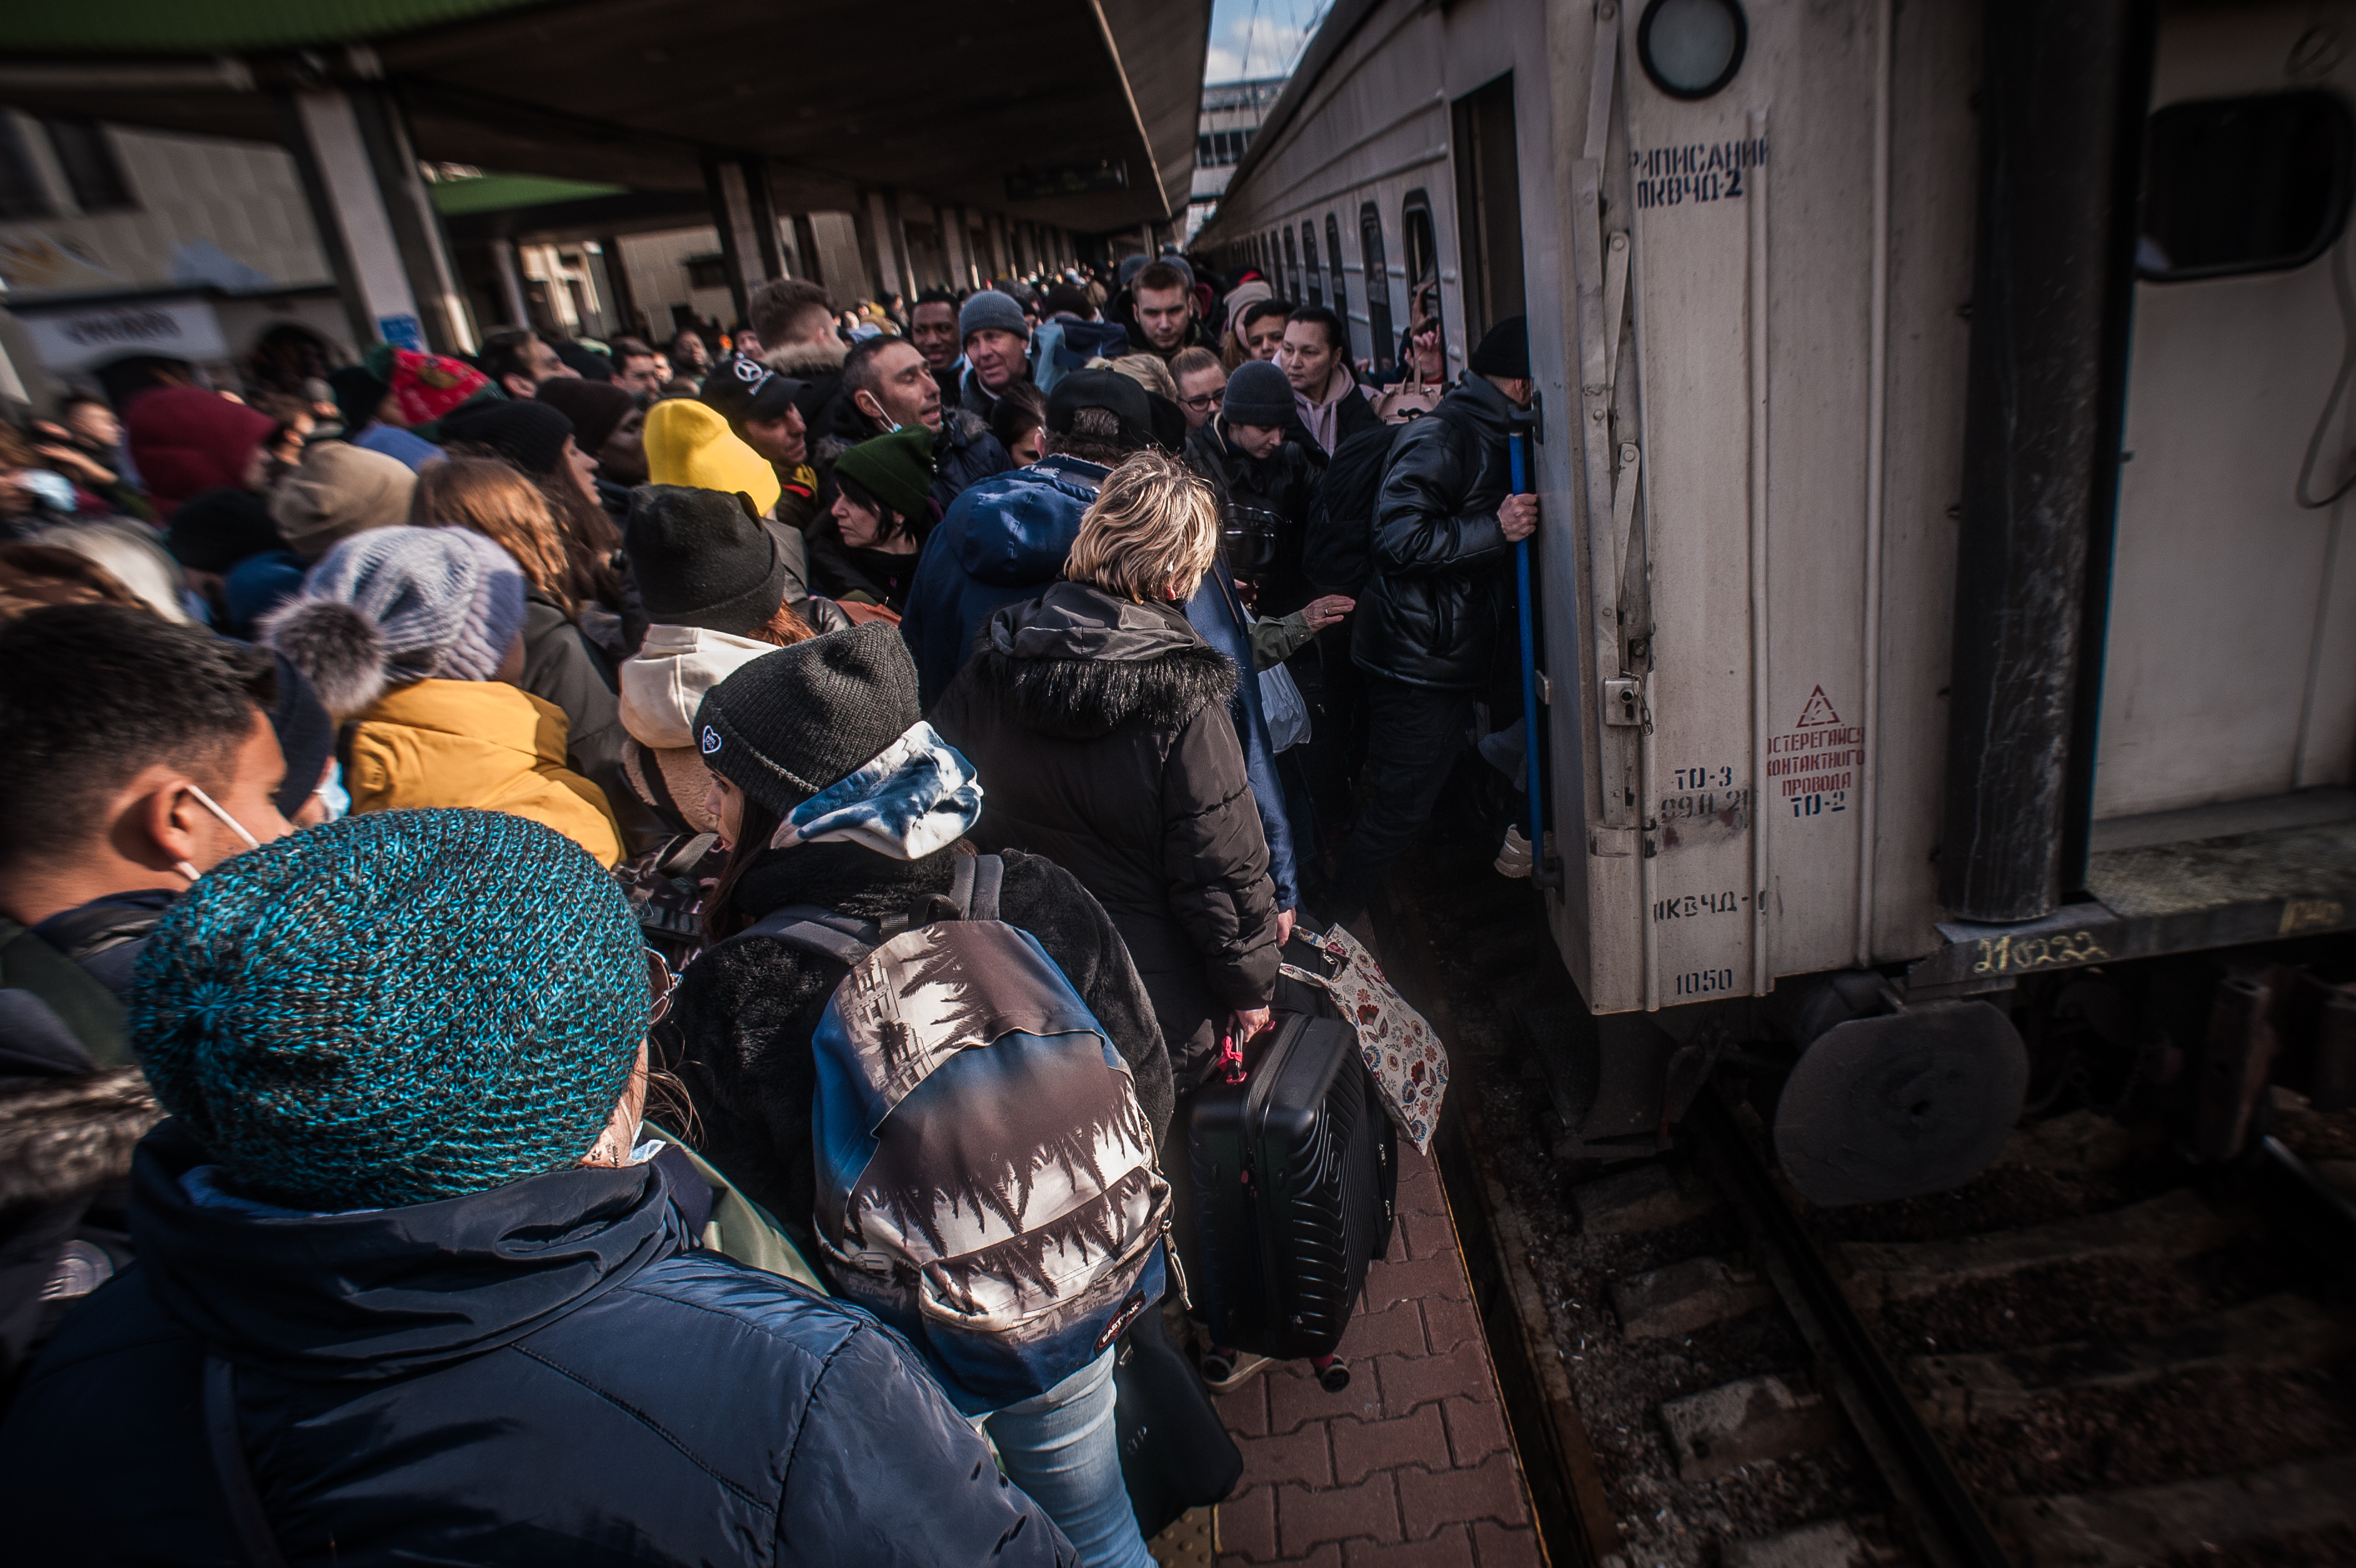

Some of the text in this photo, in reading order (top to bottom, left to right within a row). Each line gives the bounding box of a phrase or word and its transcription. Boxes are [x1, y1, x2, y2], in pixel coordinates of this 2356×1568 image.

[1674, 766, 1732, 790] ТО-3
[1782, 772, 1852, 797] ПРОВОДА
[1791, 791, 1847, 817] ТО-2
[1675, 968, 1732, 996] 1050
[1102, 1302, 1140, 1343] EASTPAK
